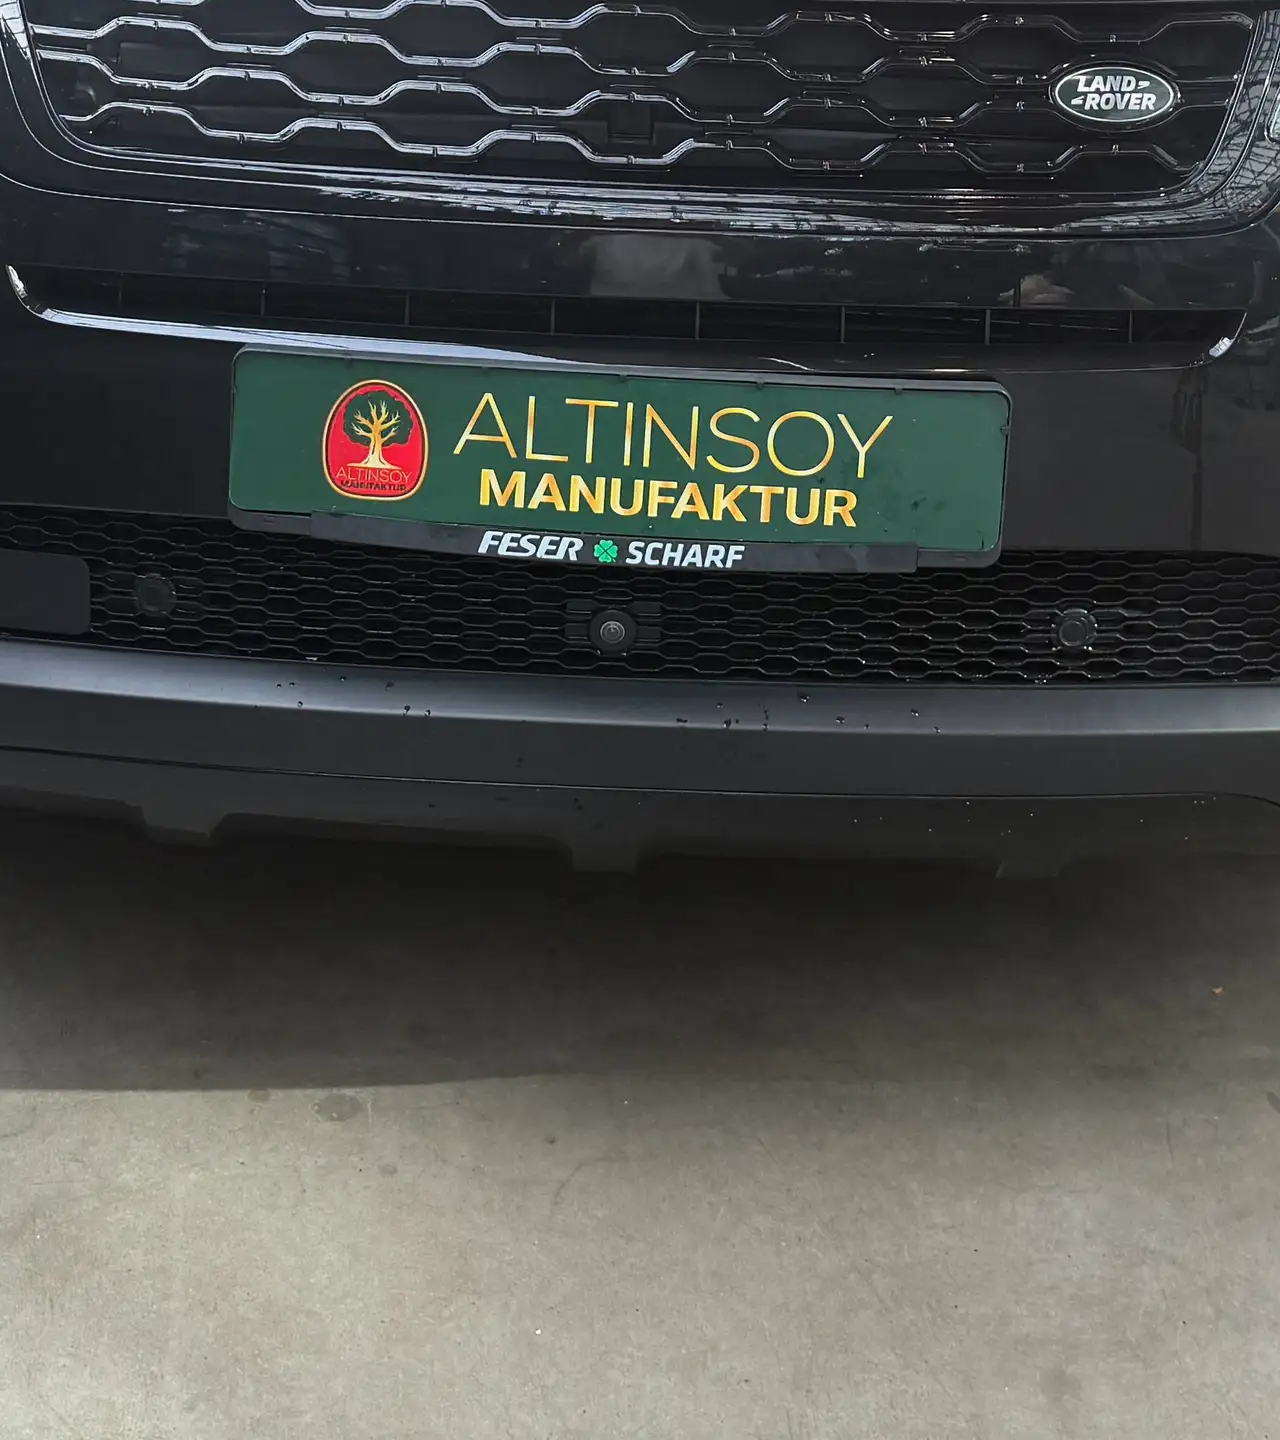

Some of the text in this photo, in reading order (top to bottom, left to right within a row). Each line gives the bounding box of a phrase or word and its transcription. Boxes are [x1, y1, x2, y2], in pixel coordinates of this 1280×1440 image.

[1076, 75, 1137, 92] LAND
[1084, 92, 1157, 110] ROVER
[453, 392, 894, 479] ALTINSOY
[335, 466, 412, 484] ALTINSOY
[478, 469, 858, 528] MANUFAKTUR
[477, 531, 745, 569] FESER SCHARF
